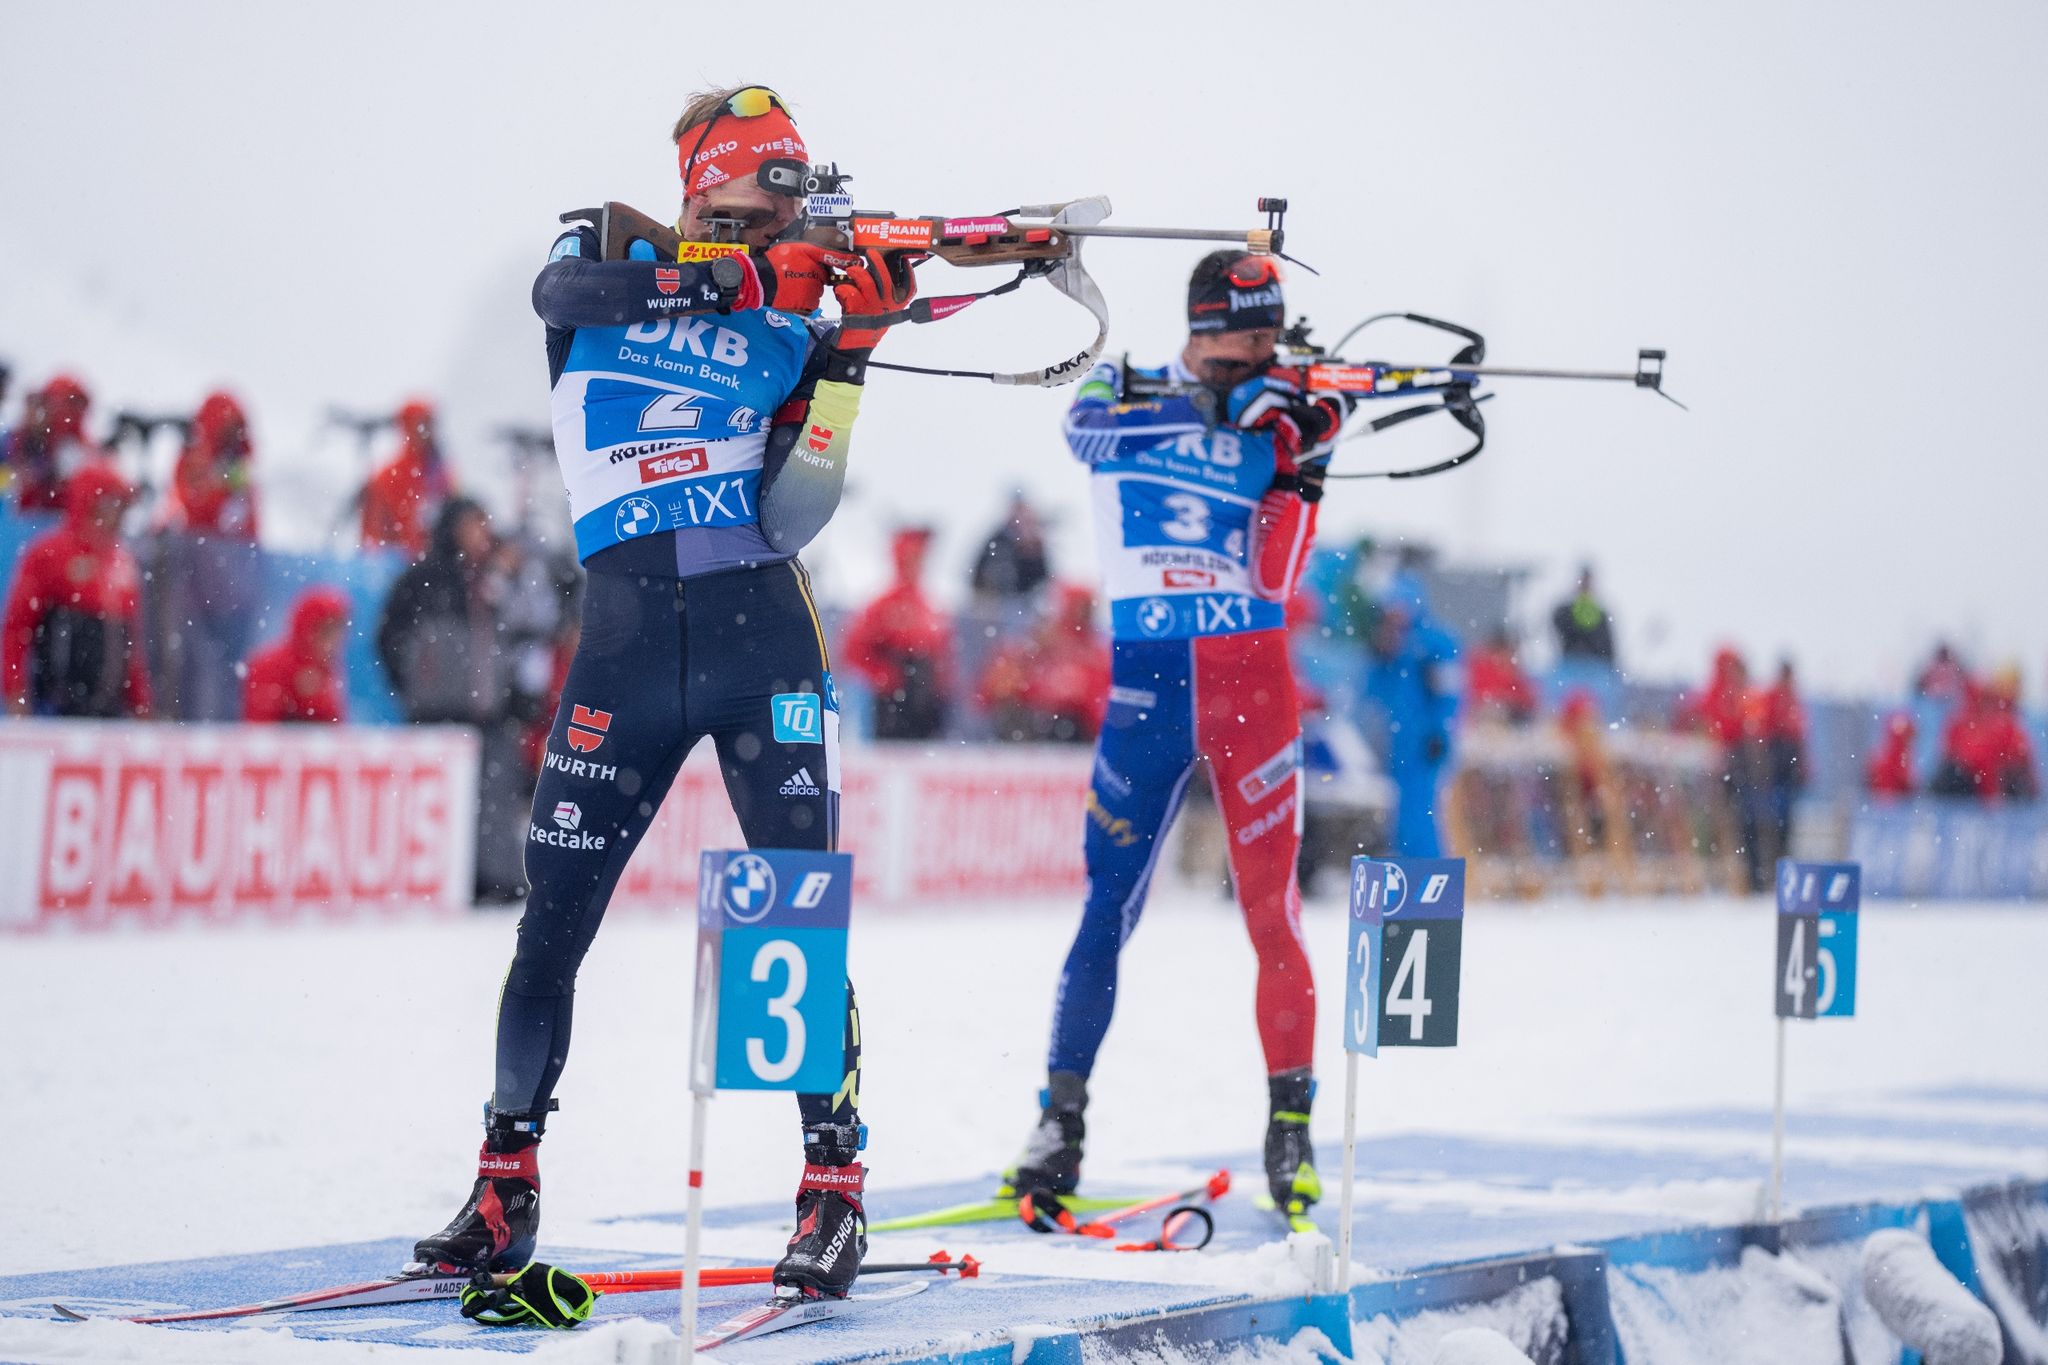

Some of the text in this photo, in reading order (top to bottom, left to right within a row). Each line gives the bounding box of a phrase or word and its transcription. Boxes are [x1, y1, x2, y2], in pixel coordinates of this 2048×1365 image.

[695, 140, 738, 165] testo
[697, 172, 731, 190] adidas
[809, 195, 851, 206] VITAMIN
[809, 205, 833, 215] WELL
[855, 221, 930, 240] VIESSMANN
[624, 316, 749, 368] DKB
[618, 346, 649, 365] Das
[654, 353, 695, 376] kann
[726, 405, 758, 434] 4
[647, 452, 700, 475] Tirol
[668, 500, 687, 530] THE
[1159, 491, 1214, 543] 3
[779, 700, 816, 738] TQ
[546, 751, 617, 781] WÜRTH
[779, 784, 820, 796] adidas
[47, 768, 446, 900] BAUHAUS
[530, 821, 606, 851] tectake
[1784, 917, 1807, 1016] 4
[1353, 928, 1432, 1046] 3 4
[746, 938, 808, 1083] 3
[804, 1172, 860, 1184] MADSHUS
[816, 1208, 854, 1274] MADSHUS
